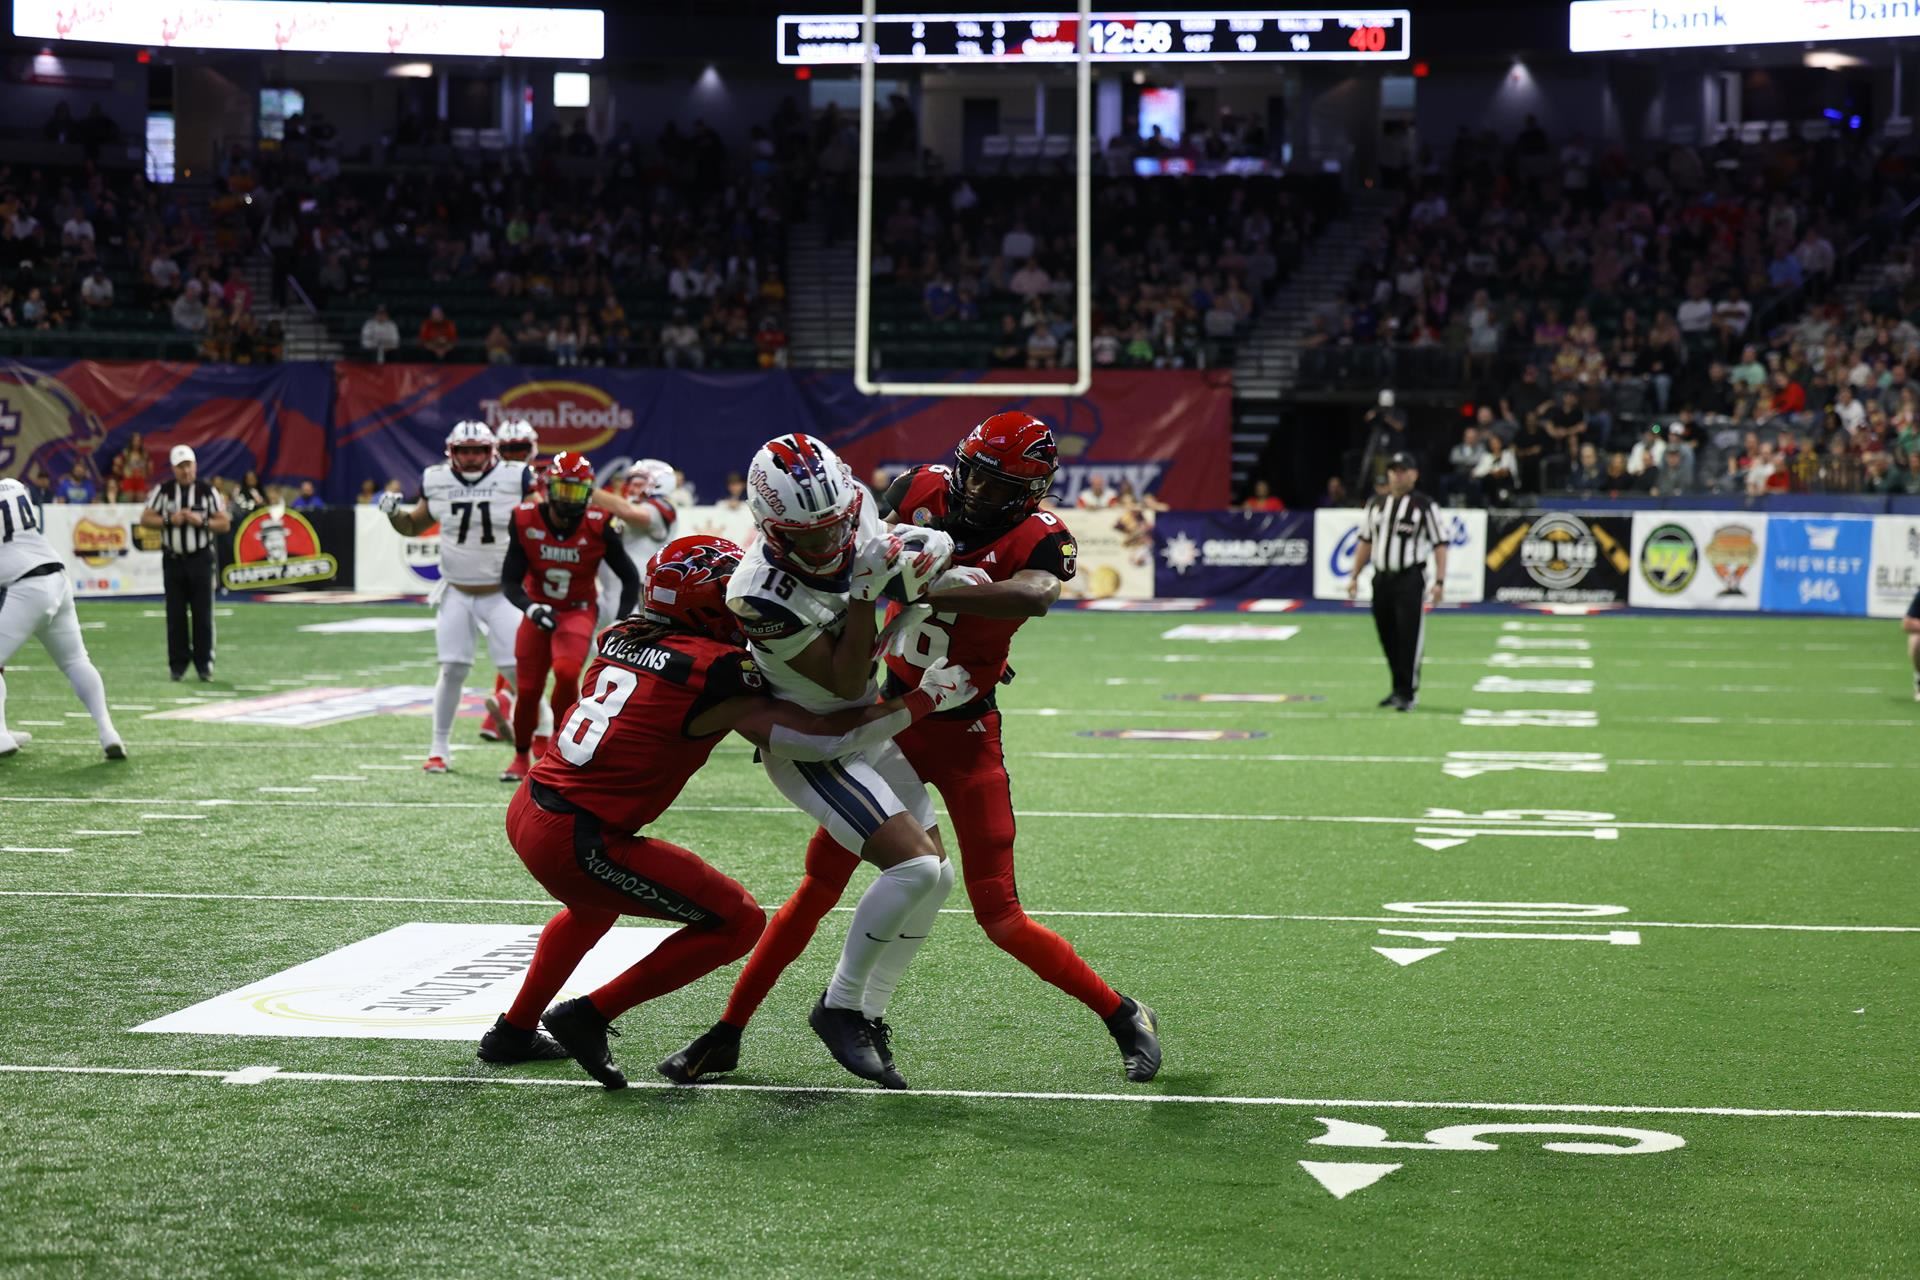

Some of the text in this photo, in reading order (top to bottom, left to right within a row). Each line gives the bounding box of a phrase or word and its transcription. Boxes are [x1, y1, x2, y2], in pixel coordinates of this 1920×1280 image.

[1652, 6, 1727, 29] bank
[1088, 22, 1172, 53] 12:56
[1349, 27, 1386, 51] 40
[480, 400, 633, 430] Tyson Foods
[451, 501, 495, 544] 71
[229, 566, 284, 584] HAPPY
[543, 568, 572, 600] 9
[761, 567, 798, 600] 15
[557, 664, 638, 767] 8
[584, 848, 706, 922] JACKSONVILLE
[1376, 901, 1641, 945] 10
[1308, 1117, 1686, 1155] 5
